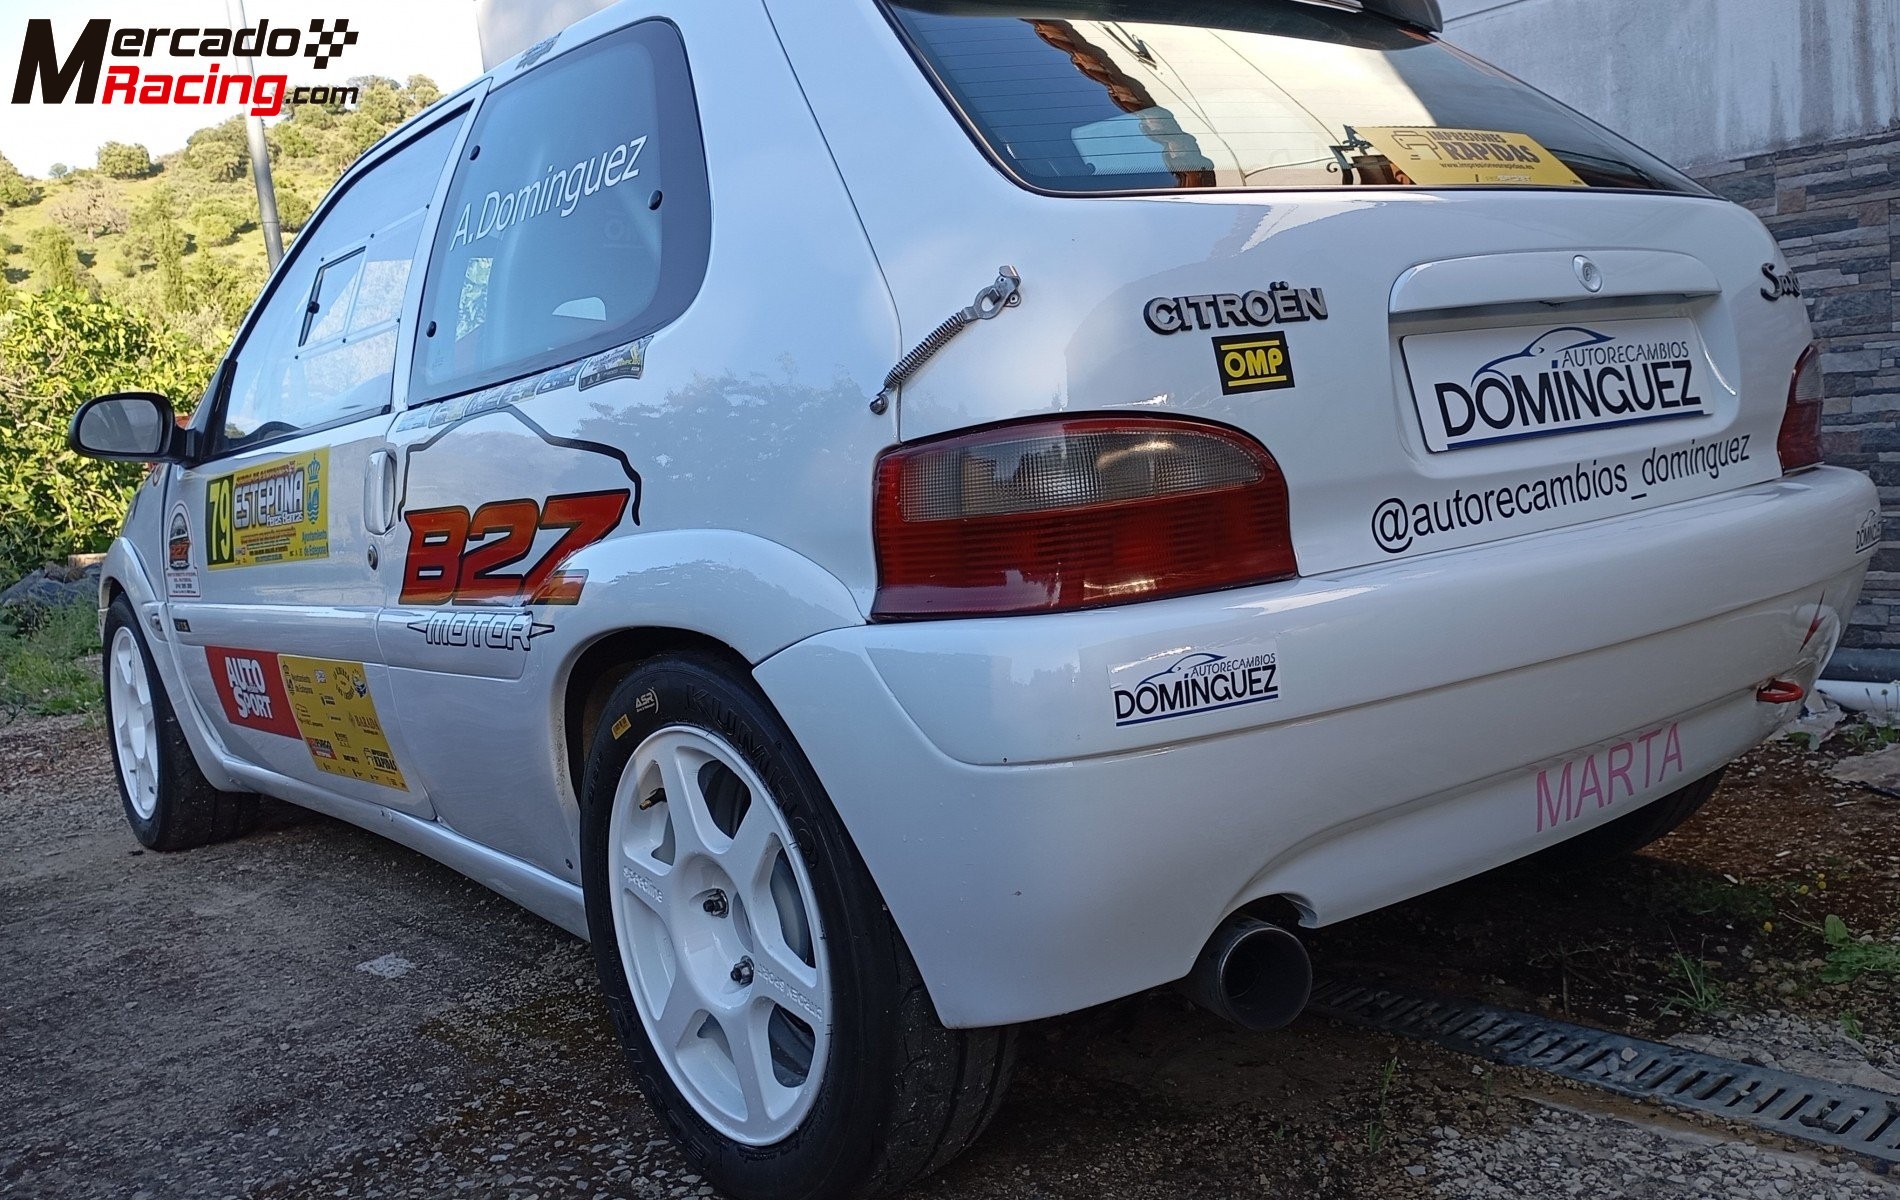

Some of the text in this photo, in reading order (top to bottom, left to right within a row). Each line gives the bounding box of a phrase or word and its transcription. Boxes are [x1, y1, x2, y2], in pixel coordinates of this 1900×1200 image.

[1426, 130, 1507, 143] IMPRESIONES
[1143, 281, 1328, 335] CITROËN
[1224, 347, 1283, 378] OMP
[1561, 341, 1689, 369] AUTORECAMBIOS
[233, 468, 305, 529] ESTEPONA
[209, 479, 231, 561] 79
[425, 610, 533, 651] MOTOR
[224, 656, 266, 694] AUTO
[1190, 653, 1276, 678] AUTORECAMBIOS
[232, 685, 273, 719] SPORT
[1536, 722, 1683, 833] MARTA
